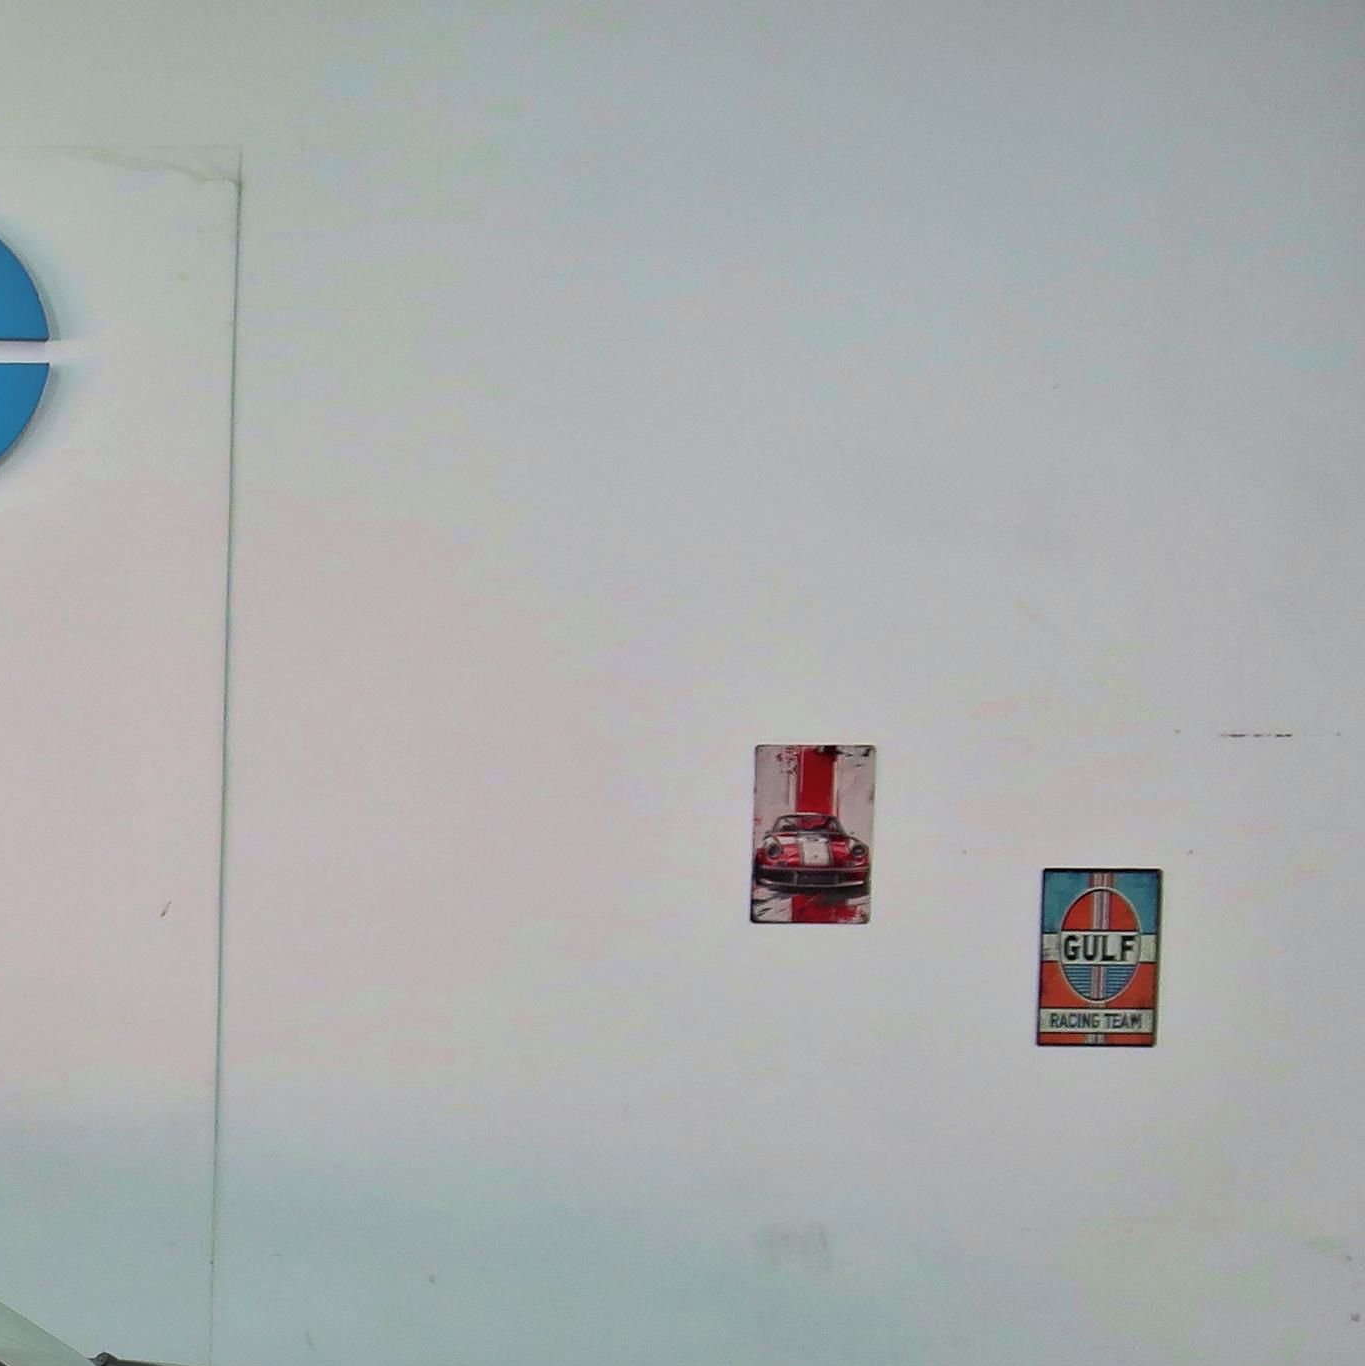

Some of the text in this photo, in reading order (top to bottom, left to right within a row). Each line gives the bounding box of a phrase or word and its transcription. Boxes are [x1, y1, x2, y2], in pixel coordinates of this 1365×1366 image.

[1063, 934, 1136, 962] GULF
[1048, 1012, 1142, 1029] RACING TEAM
